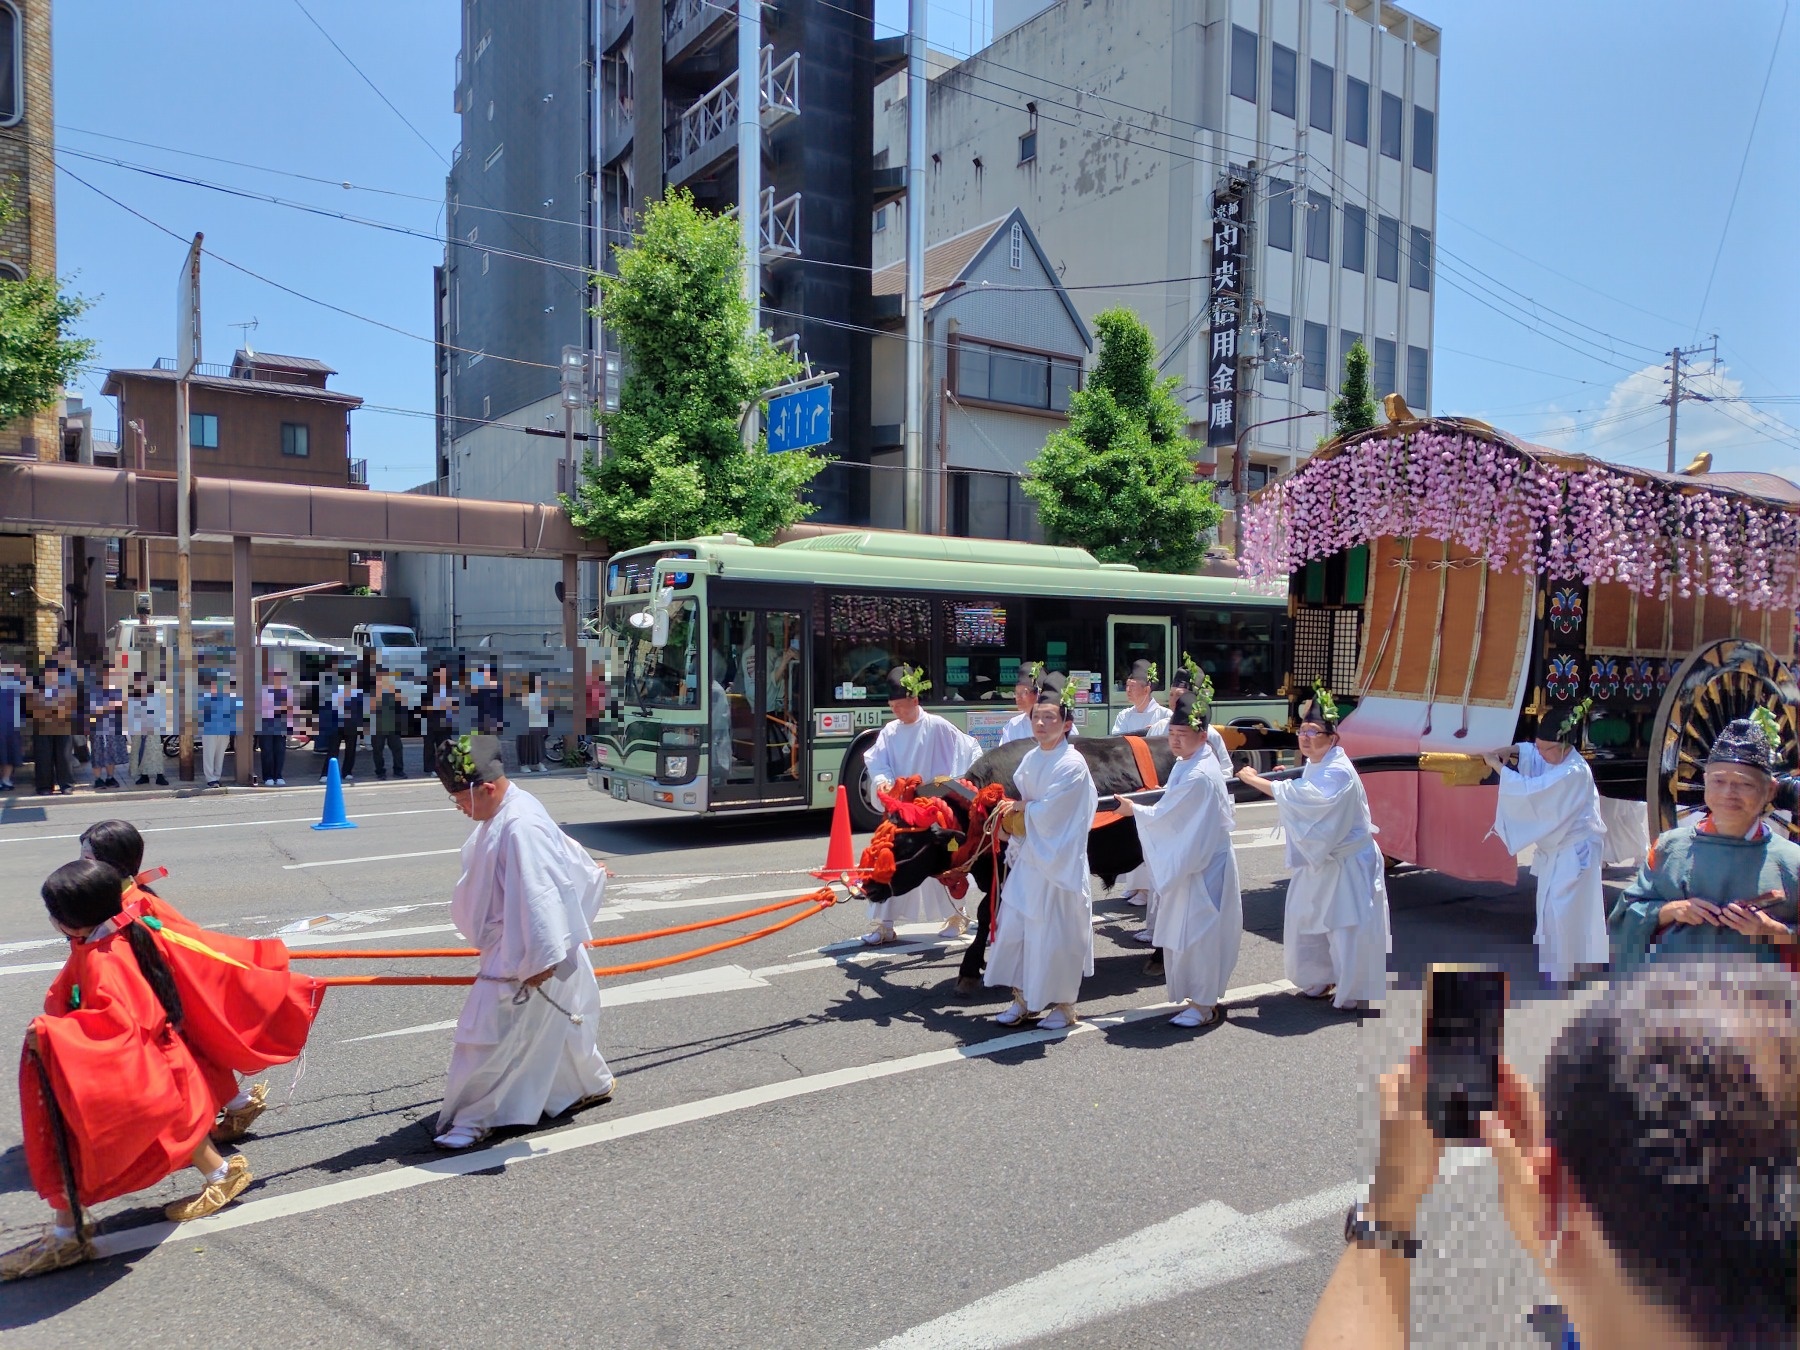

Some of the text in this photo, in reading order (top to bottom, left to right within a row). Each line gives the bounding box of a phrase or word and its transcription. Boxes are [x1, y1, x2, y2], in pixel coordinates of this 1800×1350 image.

[1216, 200, 1239, 218] 京都
[1210, 225, 1238, 429] 中央信用金庫
[833, 714, 848, 723] 出口
[856, 712, 879, 725] 4151
